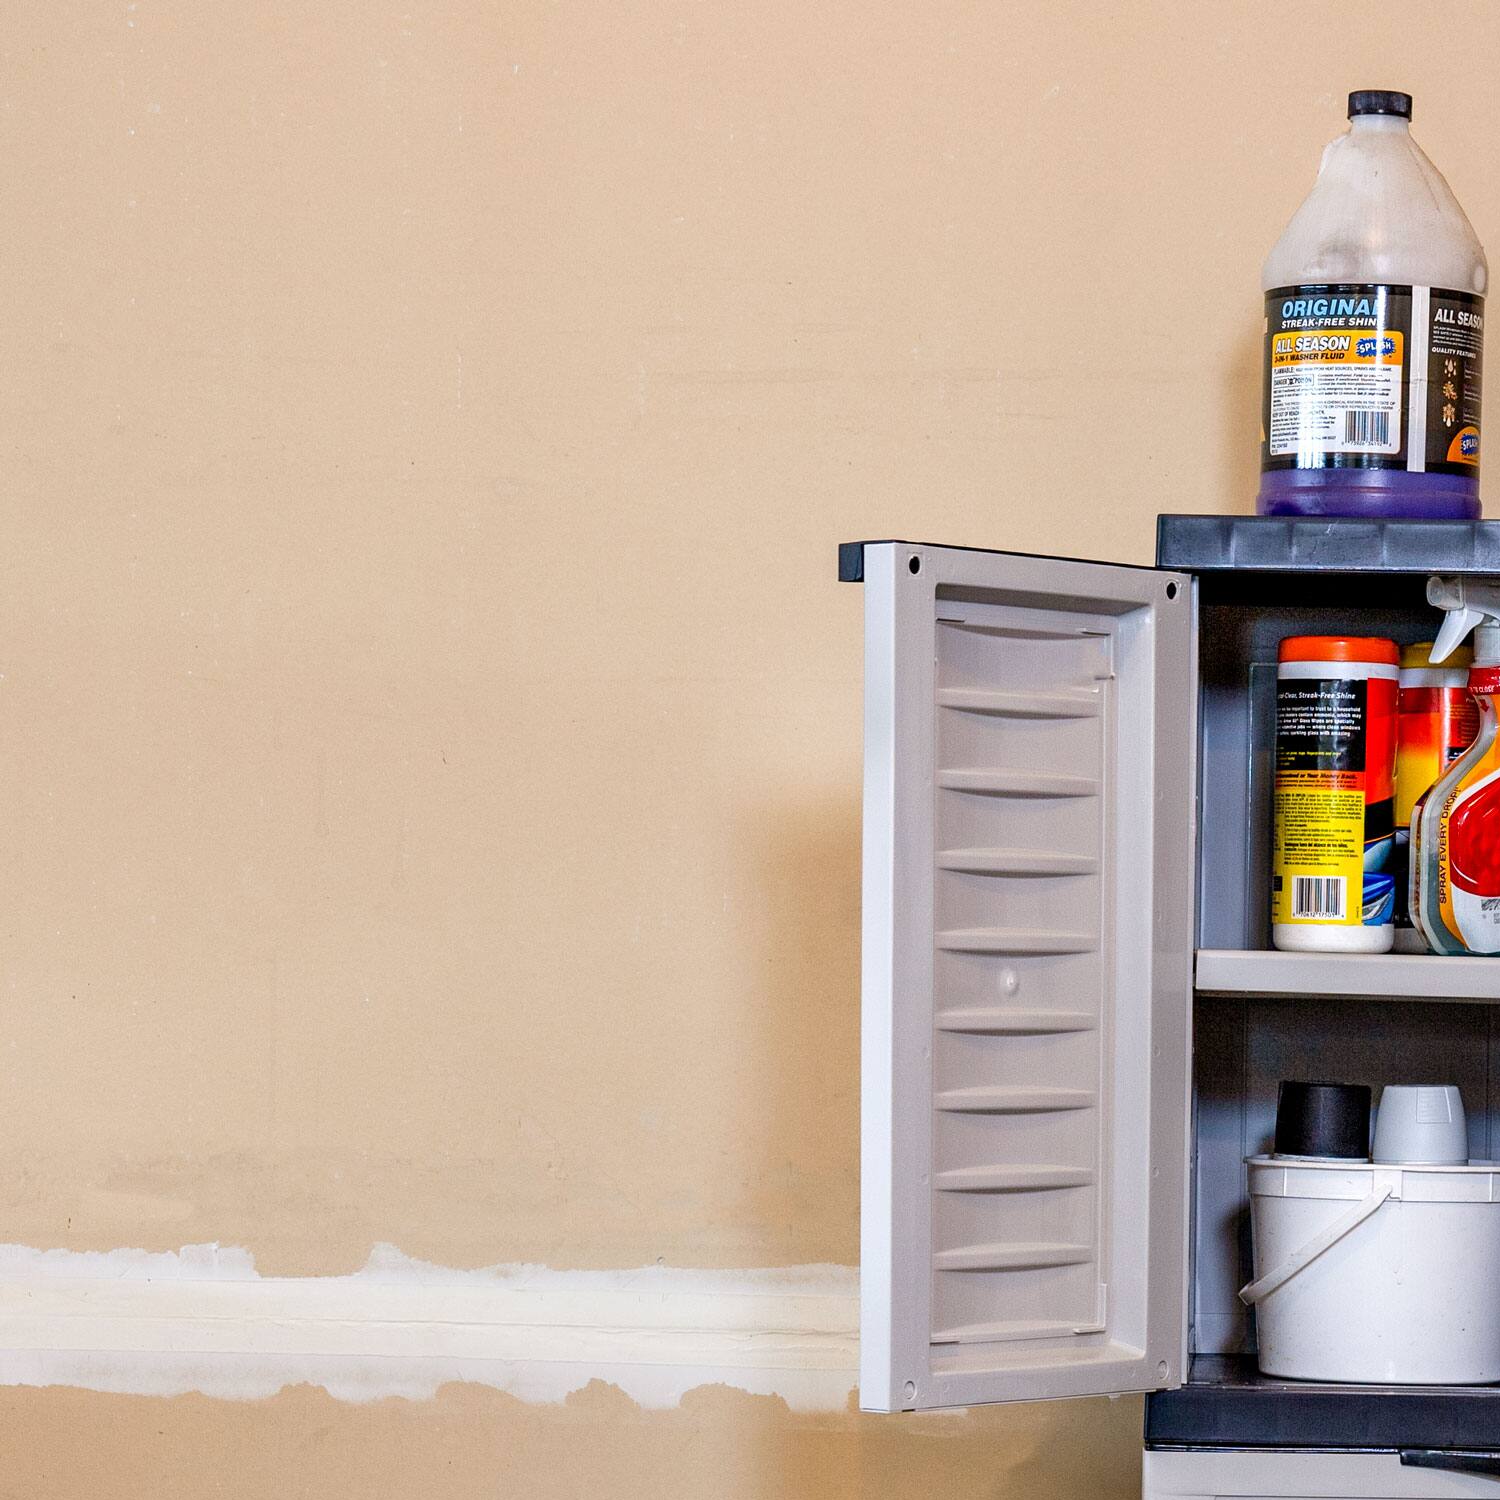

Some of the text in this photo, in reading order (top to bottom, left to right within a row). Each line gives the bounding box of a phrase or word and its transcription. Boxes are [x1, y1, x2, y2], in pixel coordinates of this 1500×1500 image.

[1434, 308, 1456, 324] ALL
[1281, 317, 1380, 329] STREAK-FREE SHIN
[1275, 336, 1351, 354] ALL SEASON
[1360, 341, 1391, 353] SPLSH
[1290, 353, 1319, 361] WASHER
[1320, 352, 1345, 360] FLUID
[1431, 346, 1477, 359] QUALITY FEATURES
